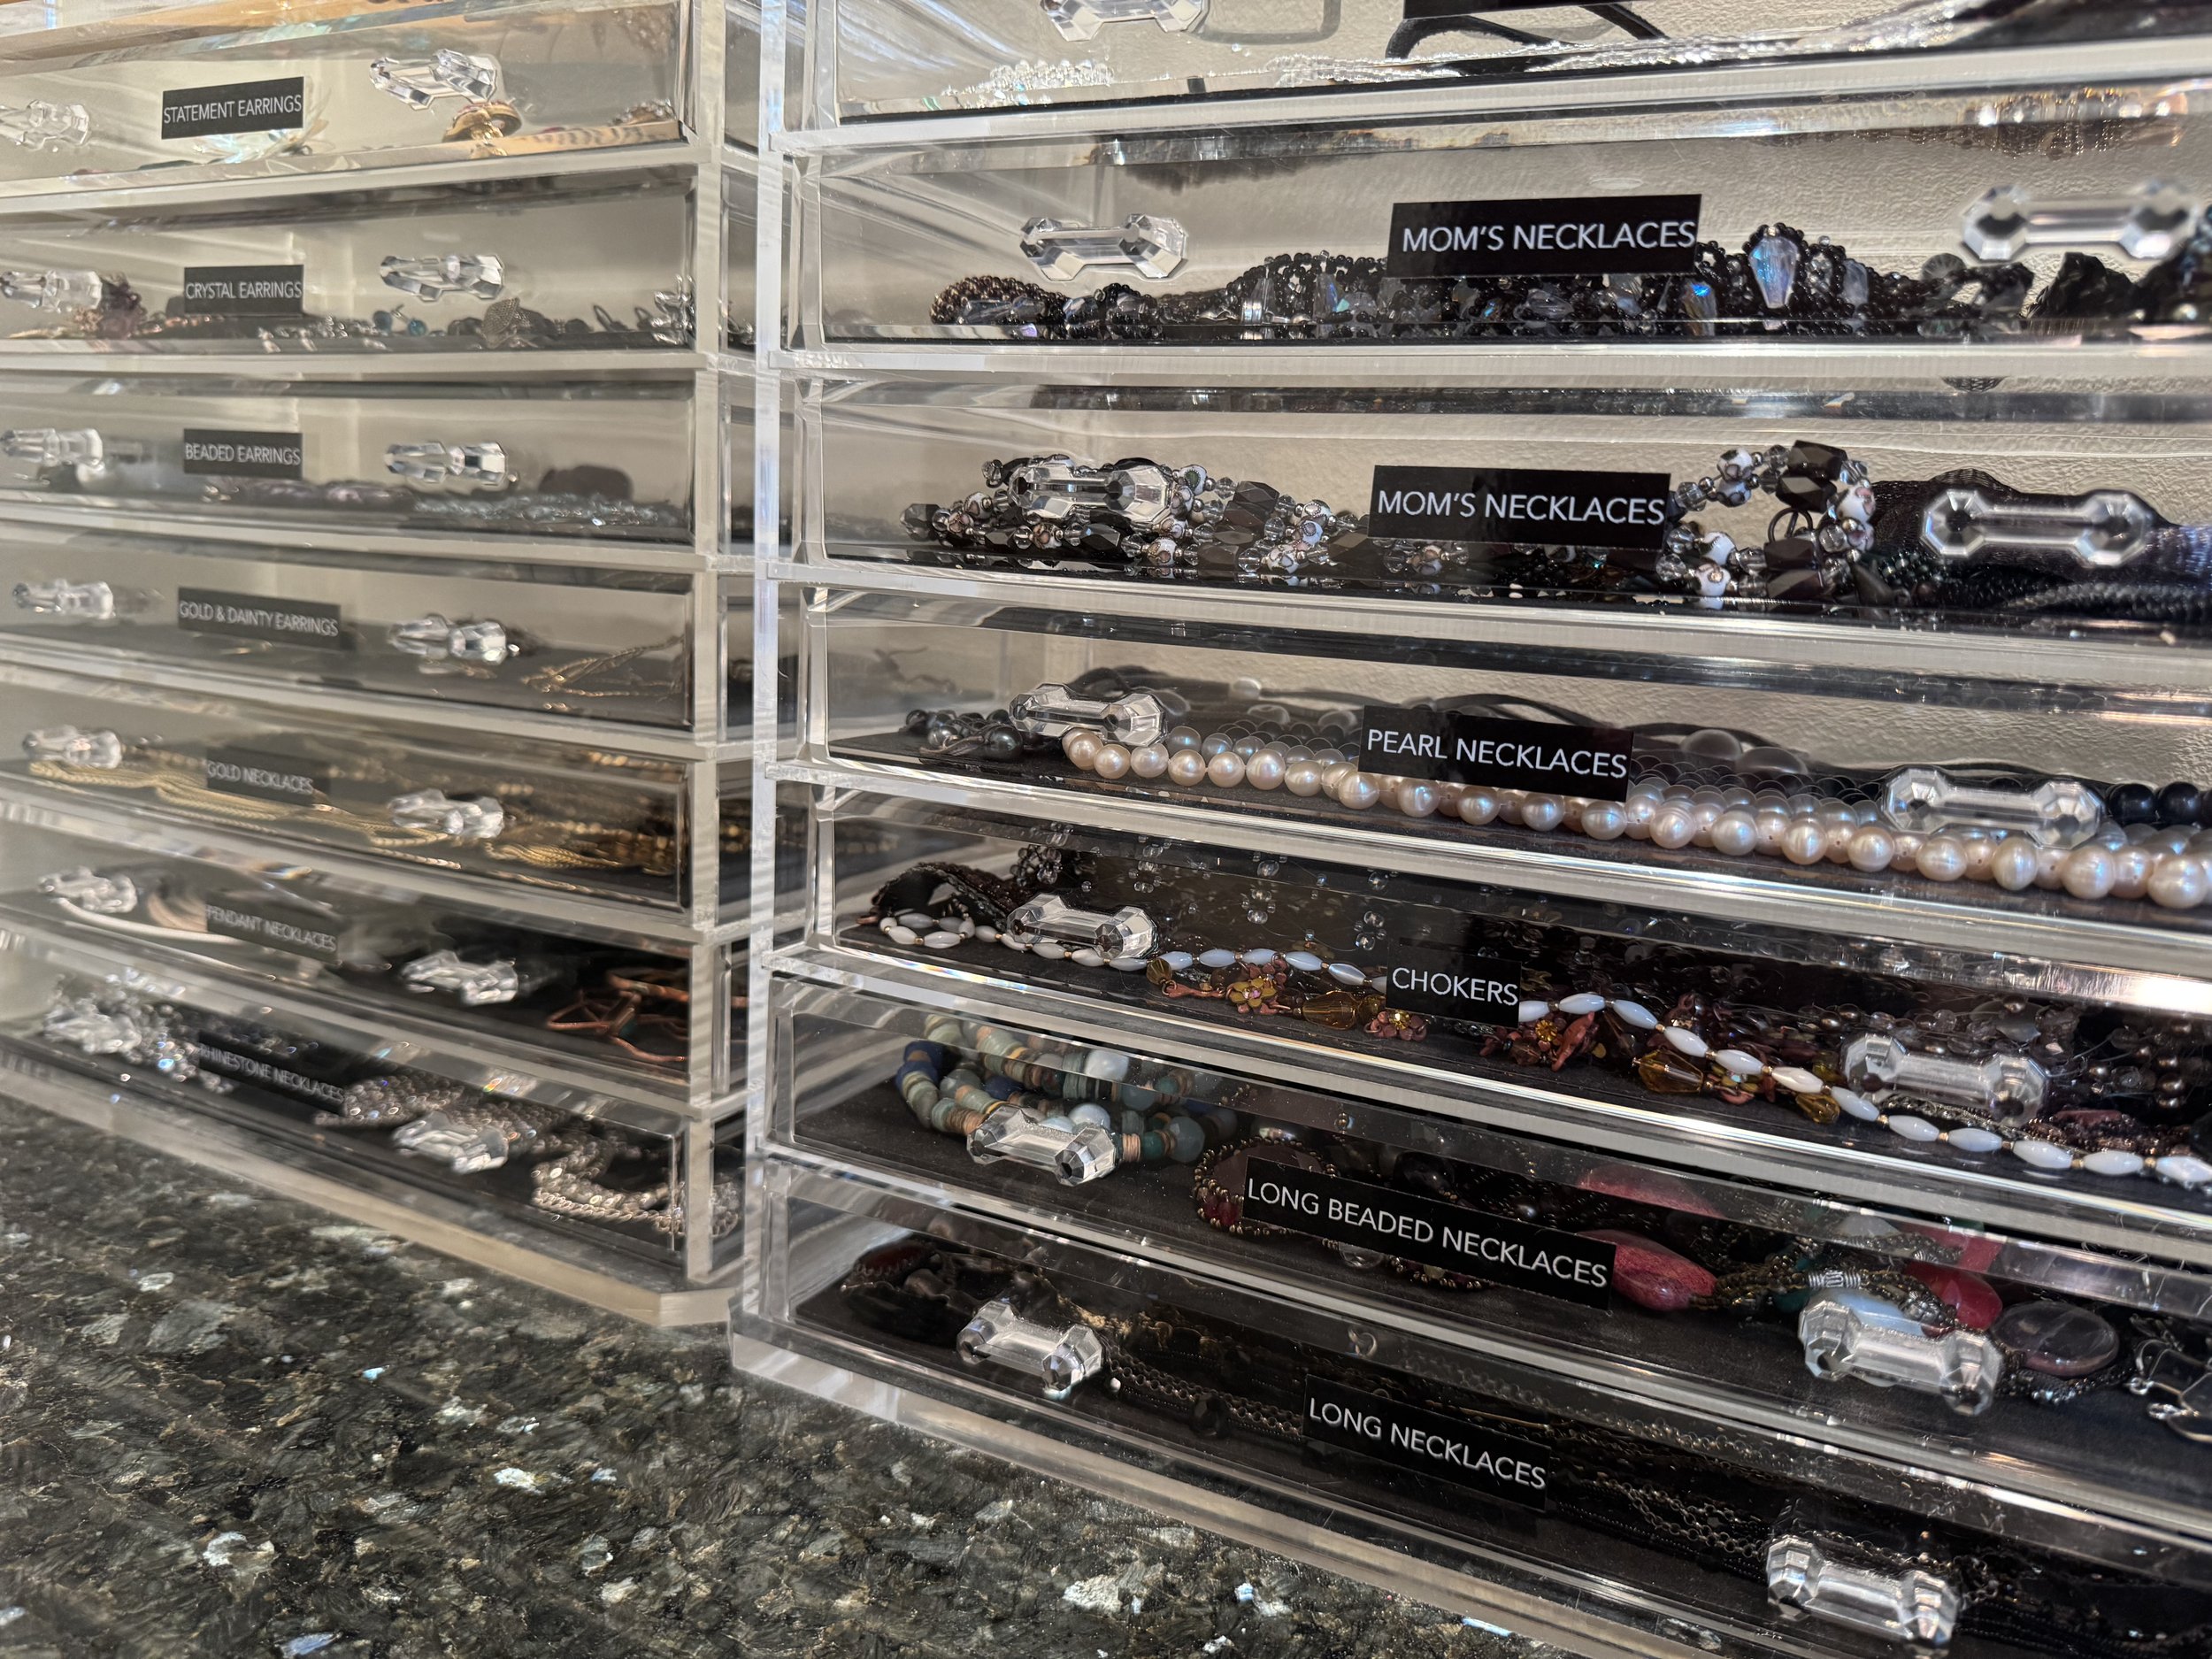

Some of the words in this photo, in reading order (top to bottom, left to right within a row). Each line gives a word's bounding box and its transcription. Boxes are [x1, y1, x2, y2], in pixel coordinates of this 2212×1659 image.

[164, 101, 234, 124] STATEMENT
[238, 95, 302, 117] EARRINGS
[1402, 225, 1504, 252] MOM'S
[1513, 220, 1695, 250] NECKLACES
[185, 281, 236, 299] CRYSTAL
[239, 280, 302, 299] EARRINGS
[185, 442, 234, 461] BEADED
[237, 445, 301, 465] EARRINGS
[1378, 490, 1476, 518] MOM'S
[1485, 494, 1665, 525] NECKLACES
[180, 601, 213, 620] GOLD
[216, 605, 227, 623] &
[227, 606, 275, 627] DAINTY
[275, 612, 339, 637] EARRINGS
[1367, 728, 1448, 759] PEARL
[1456, 738, 1627, 779] NECKLACES
[207, 761, 241, 782] GOLD
[242, 766, 314, 795] NECKLACES
[265, 920, 336, 952] NECKLACES
[1392, 967, 1519, 1006] CHOKERS
[273, 1068, 345, 1105] NECKLACES
[1248, 1179, 1319, 1215] LONG
[1328, 1199, 1433, 1242] BEADED
[1442, 1226, 1608, 1288] NECKLACES
[1310, 1398, 1382, 1439] LONG
[1390, 1423, 1547, 1490] NECKLACES
